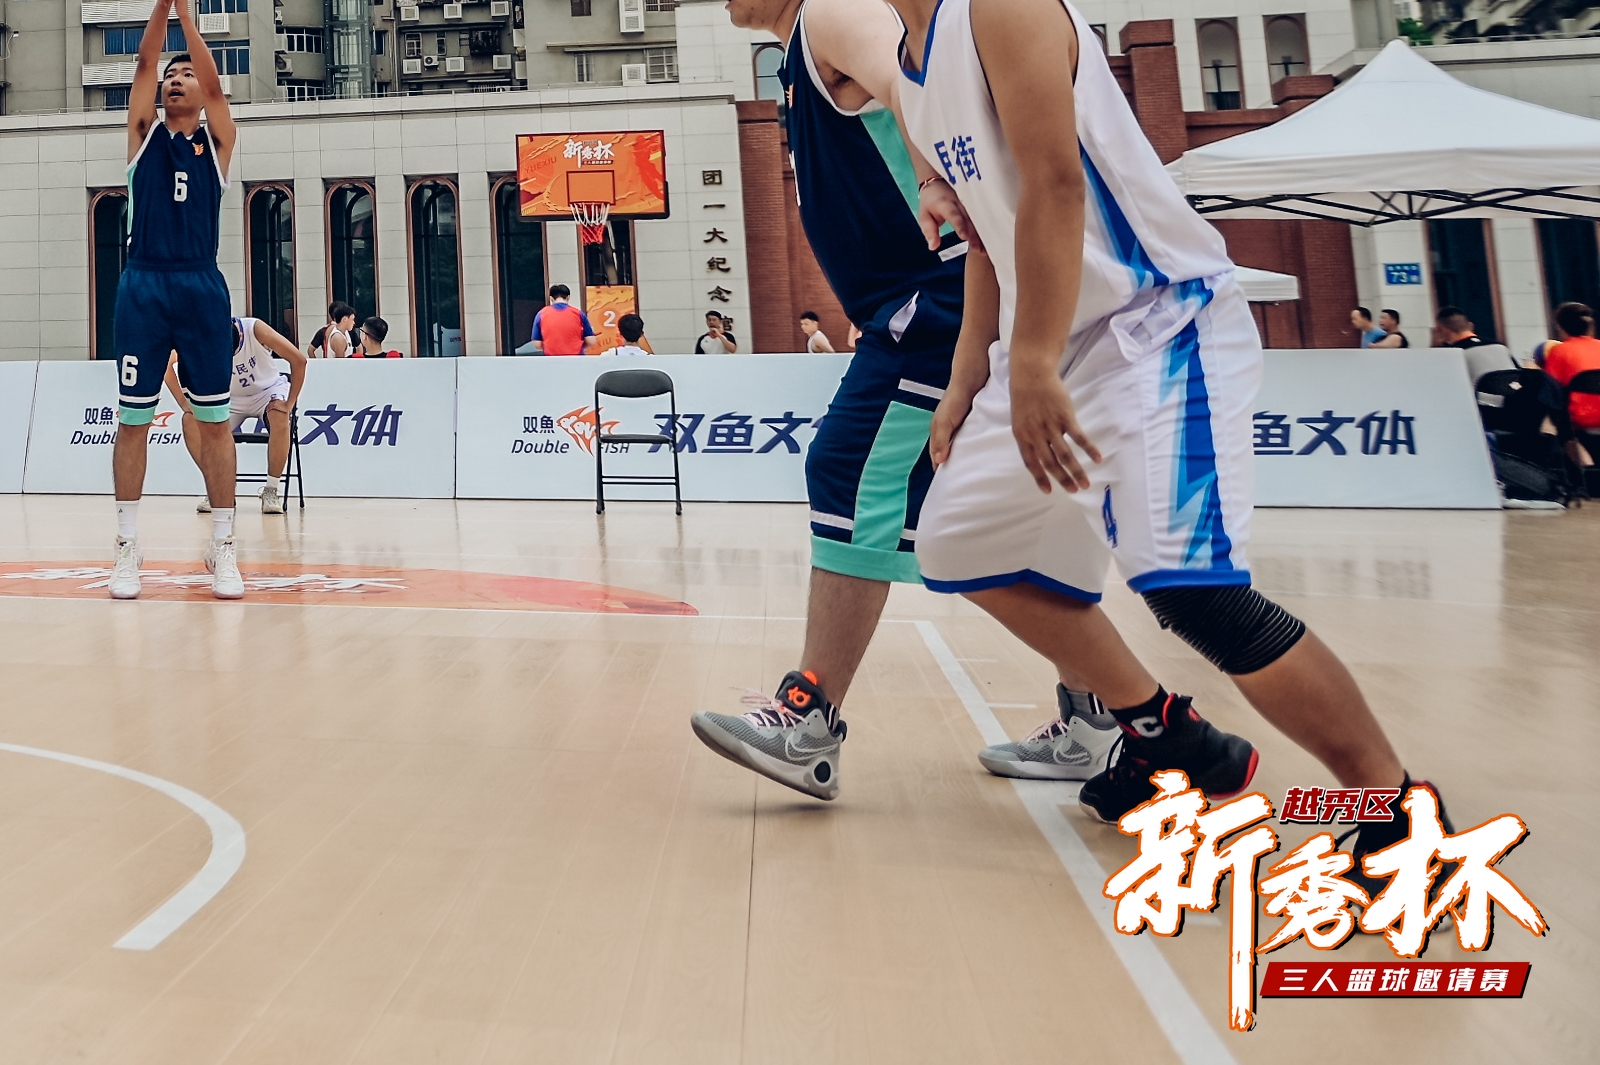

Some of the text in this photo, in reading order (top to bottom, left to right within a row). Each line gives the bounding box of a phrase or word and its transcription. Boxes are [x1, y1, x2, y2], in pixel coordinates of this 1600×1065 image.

[174, 171, 188, 202] 6
[603, 310, 617, 327] 2
[121, 354, 139, 387] 6
[239, 374, 256, 388] 21
[70, 430, 183, 445] Doubl FISH
[647, 411, 824, 454] 双鱼文
[511, 439, 570, 454] Double
